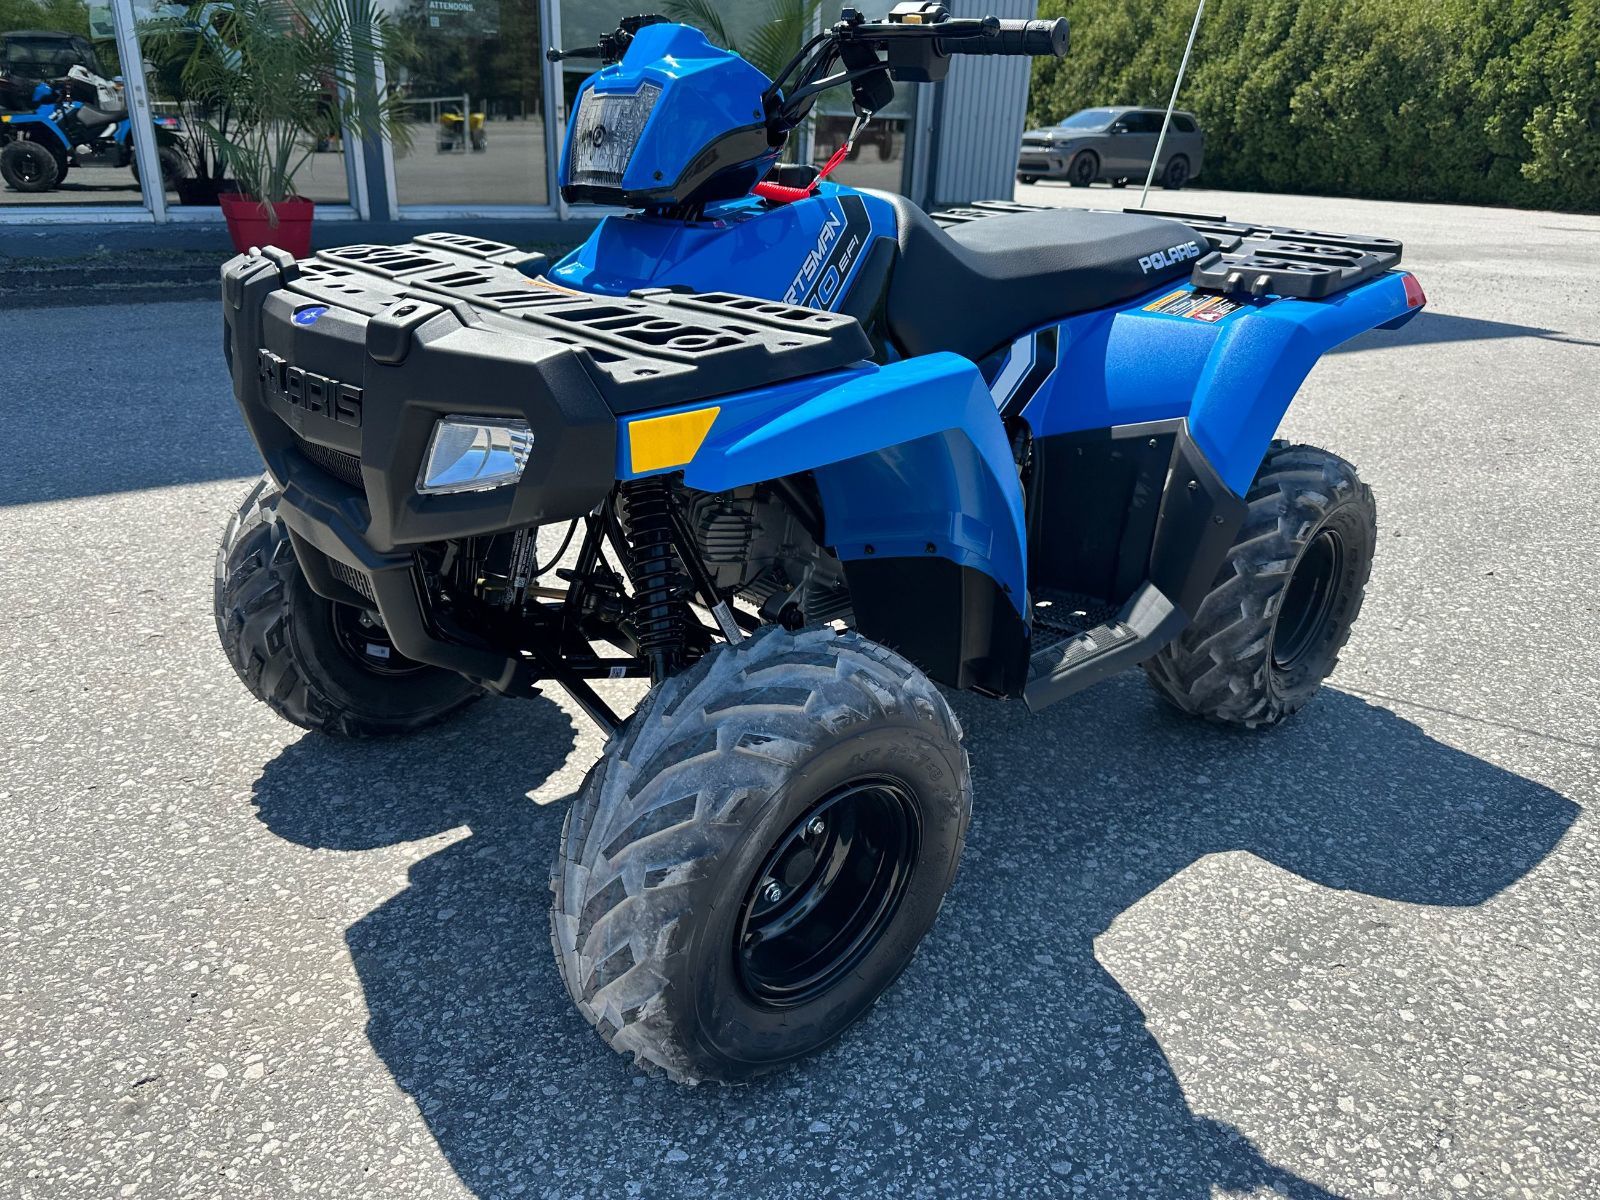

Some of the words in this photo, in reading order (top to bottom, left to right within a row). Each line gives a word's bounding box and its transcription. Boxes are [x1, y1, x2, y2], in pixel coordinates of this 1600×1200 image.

[781, 211, 841, 305] RTSMAN
[838, 234, 859, 273] EFI
[1138, 240, 1200, 274] POLARIS
